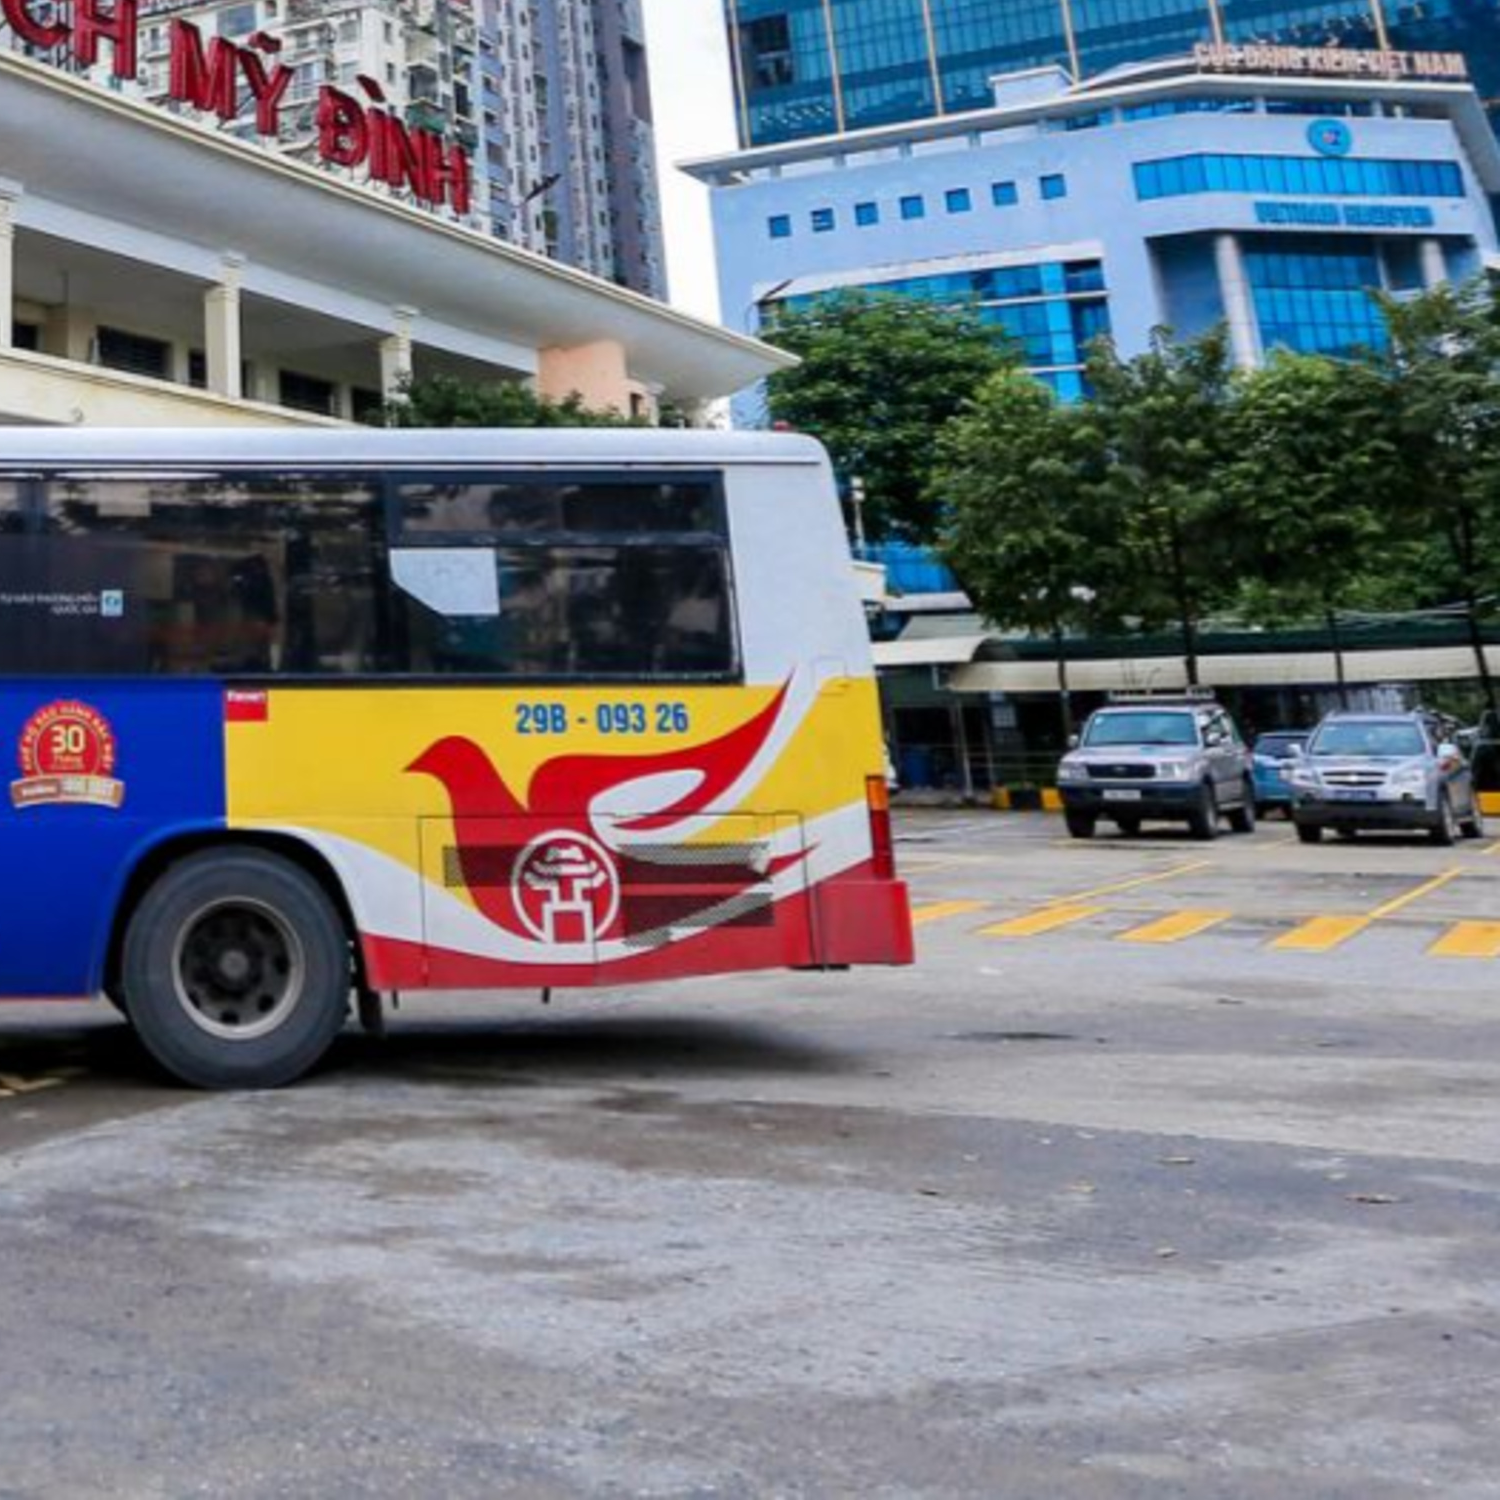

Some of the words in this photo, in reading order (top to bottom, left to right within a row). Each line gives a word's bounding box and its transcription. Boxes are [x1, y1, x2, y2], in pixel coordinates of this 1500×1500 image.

[1413, 52, 1468, 76] NAM
[169, 18, 295, 136] MỸ
[315, 74, 472, 215] ĐÌNH
[515, 703, 567, 734] 29B
[596, 703, 646, 734] 093
[656, 703, 688, 734] 26
[50, 724, 85, 755] 30
